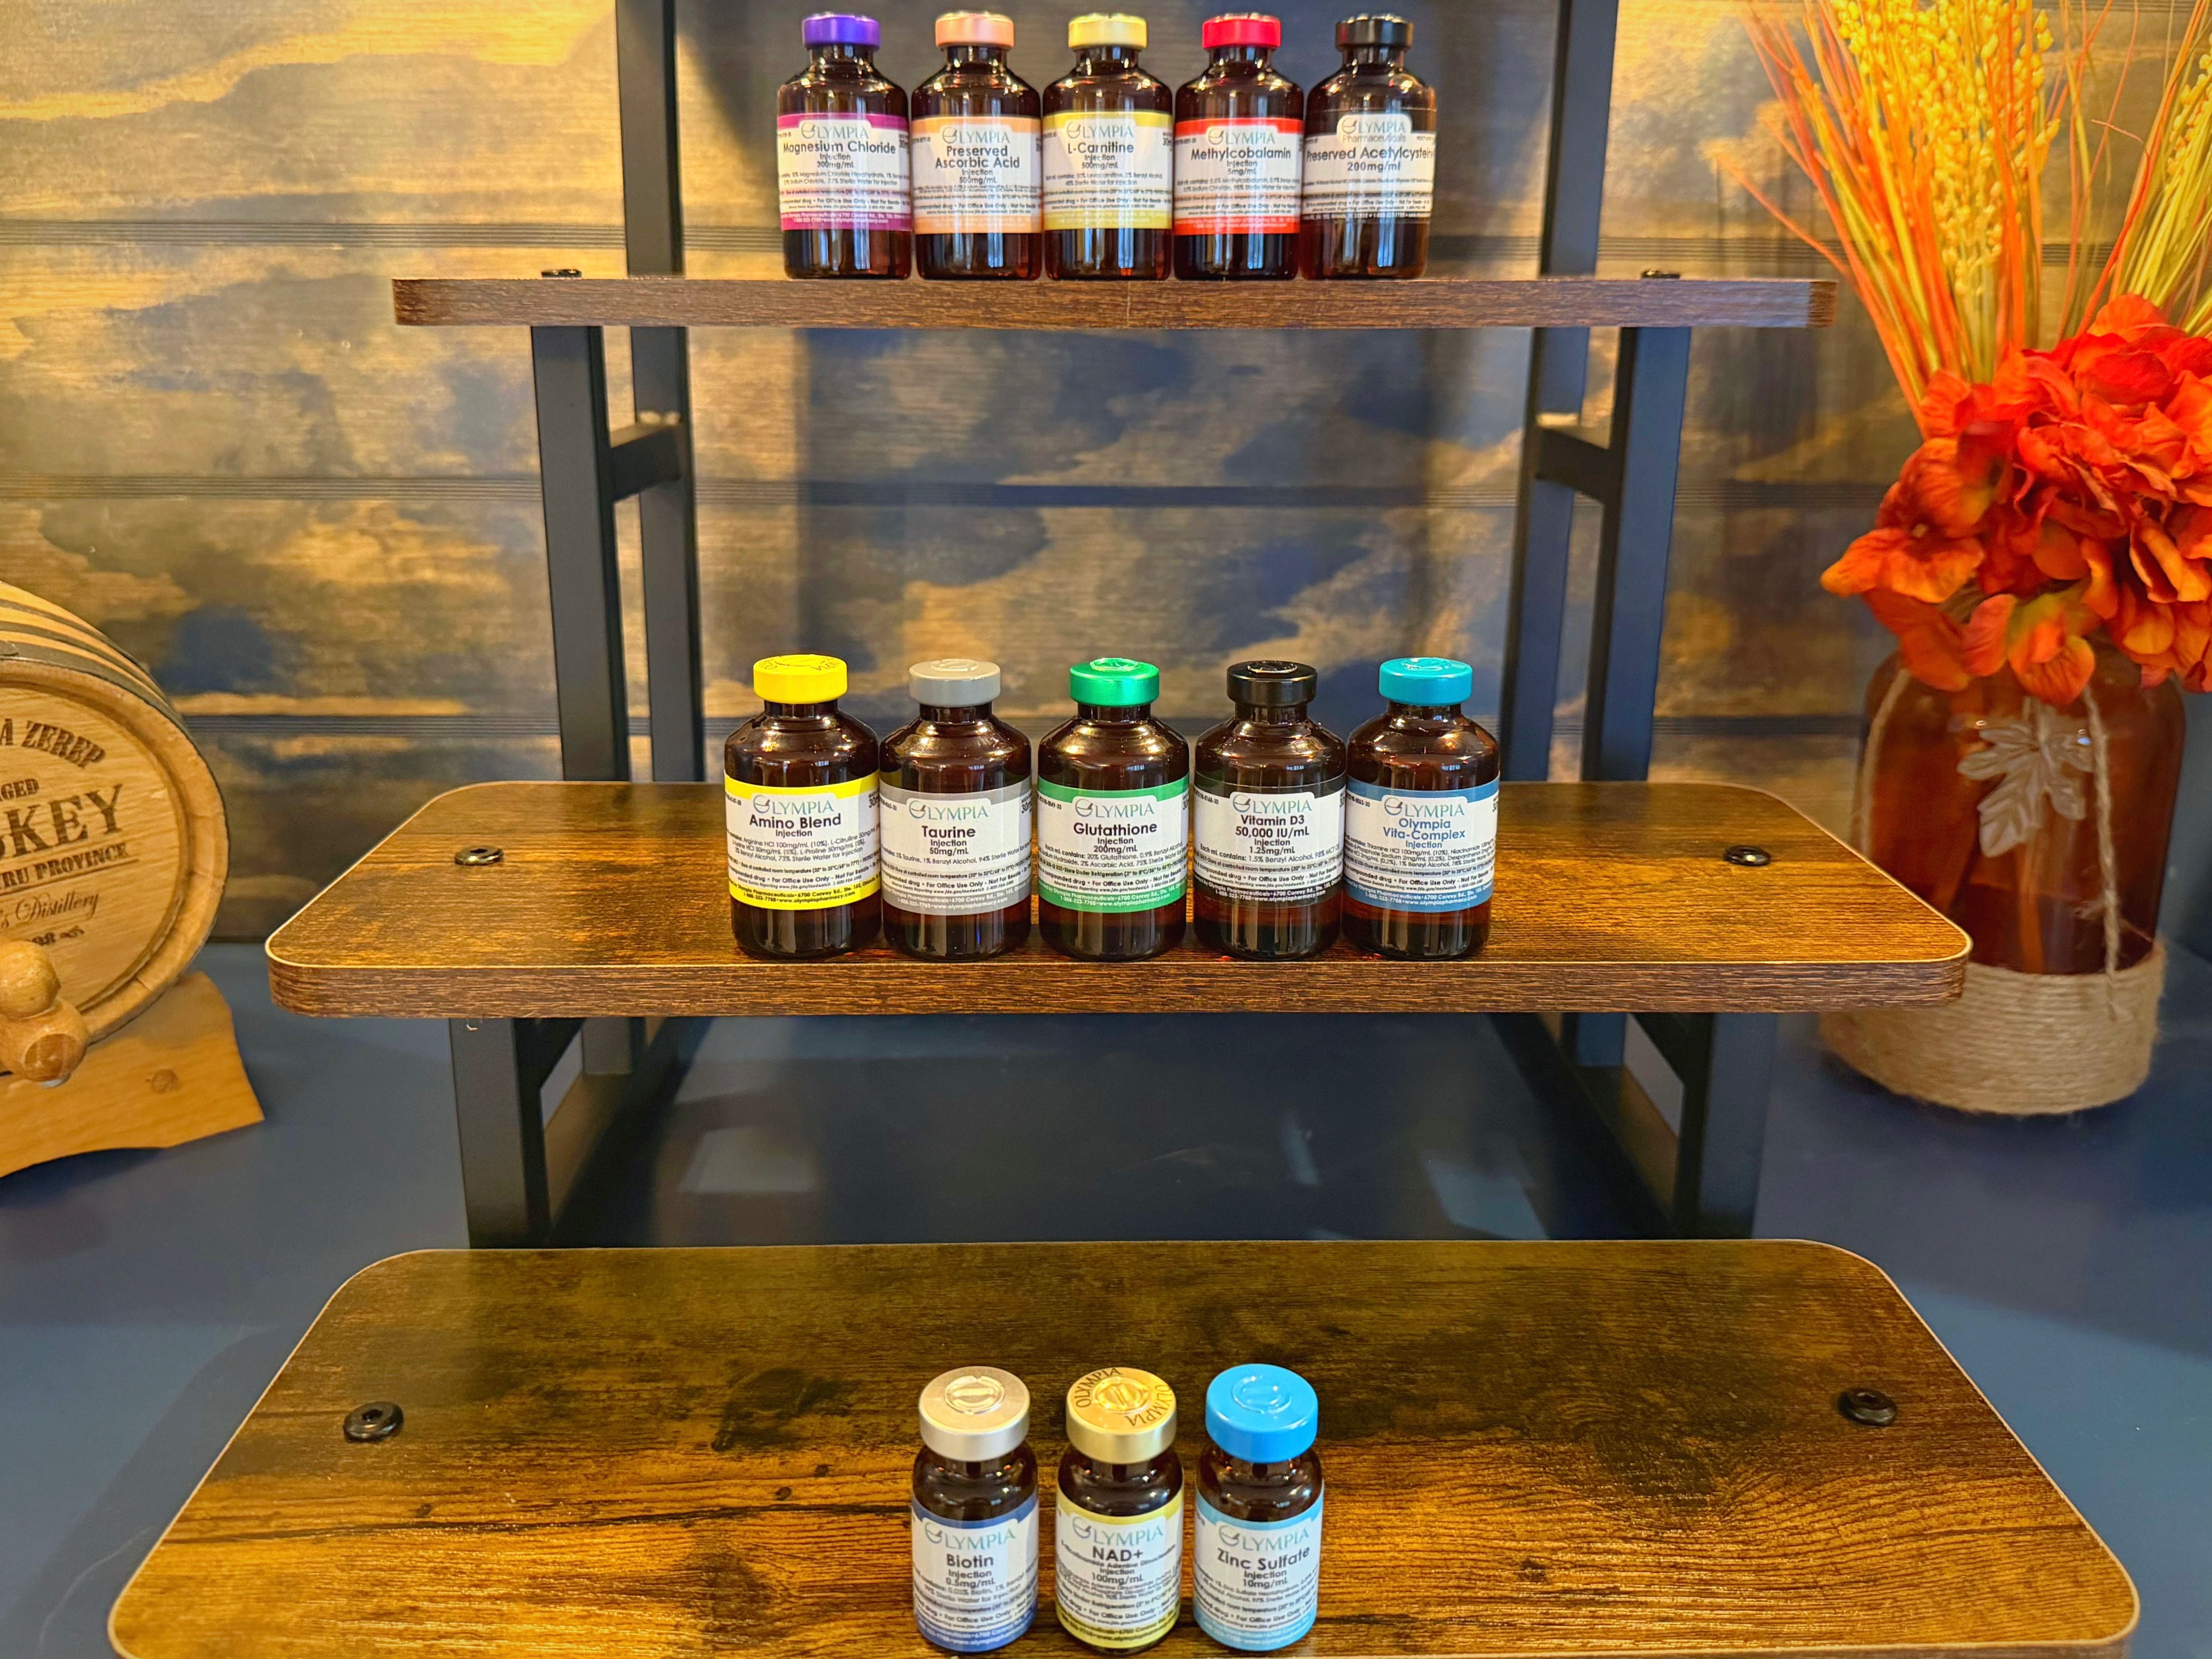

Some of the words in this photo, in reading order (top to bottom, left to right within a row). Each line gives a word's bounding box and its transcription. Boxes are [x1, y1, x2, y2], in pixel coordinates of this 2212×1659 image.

[1343, 135, 1406, 143] Pharmaceuticals
[784, 140, 843, 155] Magnesium
[848, 140, 896, 154] Chloride
[947, 145, 1008, 157] Preserved
[1068, 141, 1134, 154] L-Carnitine
[1191, 147, 1291, 161] Methylcobalamin
[1307, 147, 1356, 162] Preserved
[935, 157, 988, 168] Ascorbic
[994, 157, 1019, 168] Acid
[1085, 154, 1115, 163] Injection
[21, 720, 105, 769] ZEREP
[753, 794, 834, 815] OLYMPIA
[909, 800, 988, 820] OLYMPIA
[1075, 798, 1155, 818] OLYMPIA
[1233, 794, 1312, 814] OLYMPIA
[1384, 797, 1464, 817] OLYMPIA
[749, 814, 794, 829] Amino
[800, 813, 841, 828] Blend
[1241, 815, 1286, 826] Vitamin
[1290, 816, 1305, 825] D3
[1399, 818, 1450, 831] Olympia
[922, 826, 976, 838] Taurine
[1074, 822, 1157, 836] Glutathione
[1235, 826, 1273, 838] 50,000
[1277, 826, 1309, 839] IU/mL
[1383, 827, 1465, 842] Vita-Complex
[1094, 845, 1137, 854] 200mg/mL
[1098, 838, 1133, 847] Injection
[1254, 839, 1290, 848] Injection
[1406, 840, 1442, 849] Injection
[842, 847, 863, 857] Injection
[930, 848, 969, 856] 50mg/mL
[1062, 850, 1085, 859] contains:
[1200, 844, 1210, 853] Each
[1219, 852, 1246, 861] contains:
[1249, 847, 1295, 855] 1.25mg/mL
[34, 842, 129, 879] PROVINCE
[16, 890, 99, 921] Distillery
[1074, 1368, 1123, 1408] OLYMPIA
[1125, 1385, 1172, 1426] OLYMPIA
[925, 1522, 1015, 1550] OLYMPIA
[1073, 1516, 1163, 1546] OLYMPIA
[1219, 1524, 1309, 1551] OLYMPIA
[1092, 1546, 1143, 1561] NAD+
[1217, 1547, 1251, 1569] Zinc
[1258, 1547, 1310, 1570] Sulfate
[947, 1554, 994, 1568] Biotin
[948, 1569, 992, 1579] Injection
[1092, 1572, 1144, 1585] 100mg/mL
[1244, 1570, 1287, 1579] Injection
[946, 1578, 996, 1589] 0.5mg/mL
[1243, 1577, 1288, 1589] 10mg/mL
